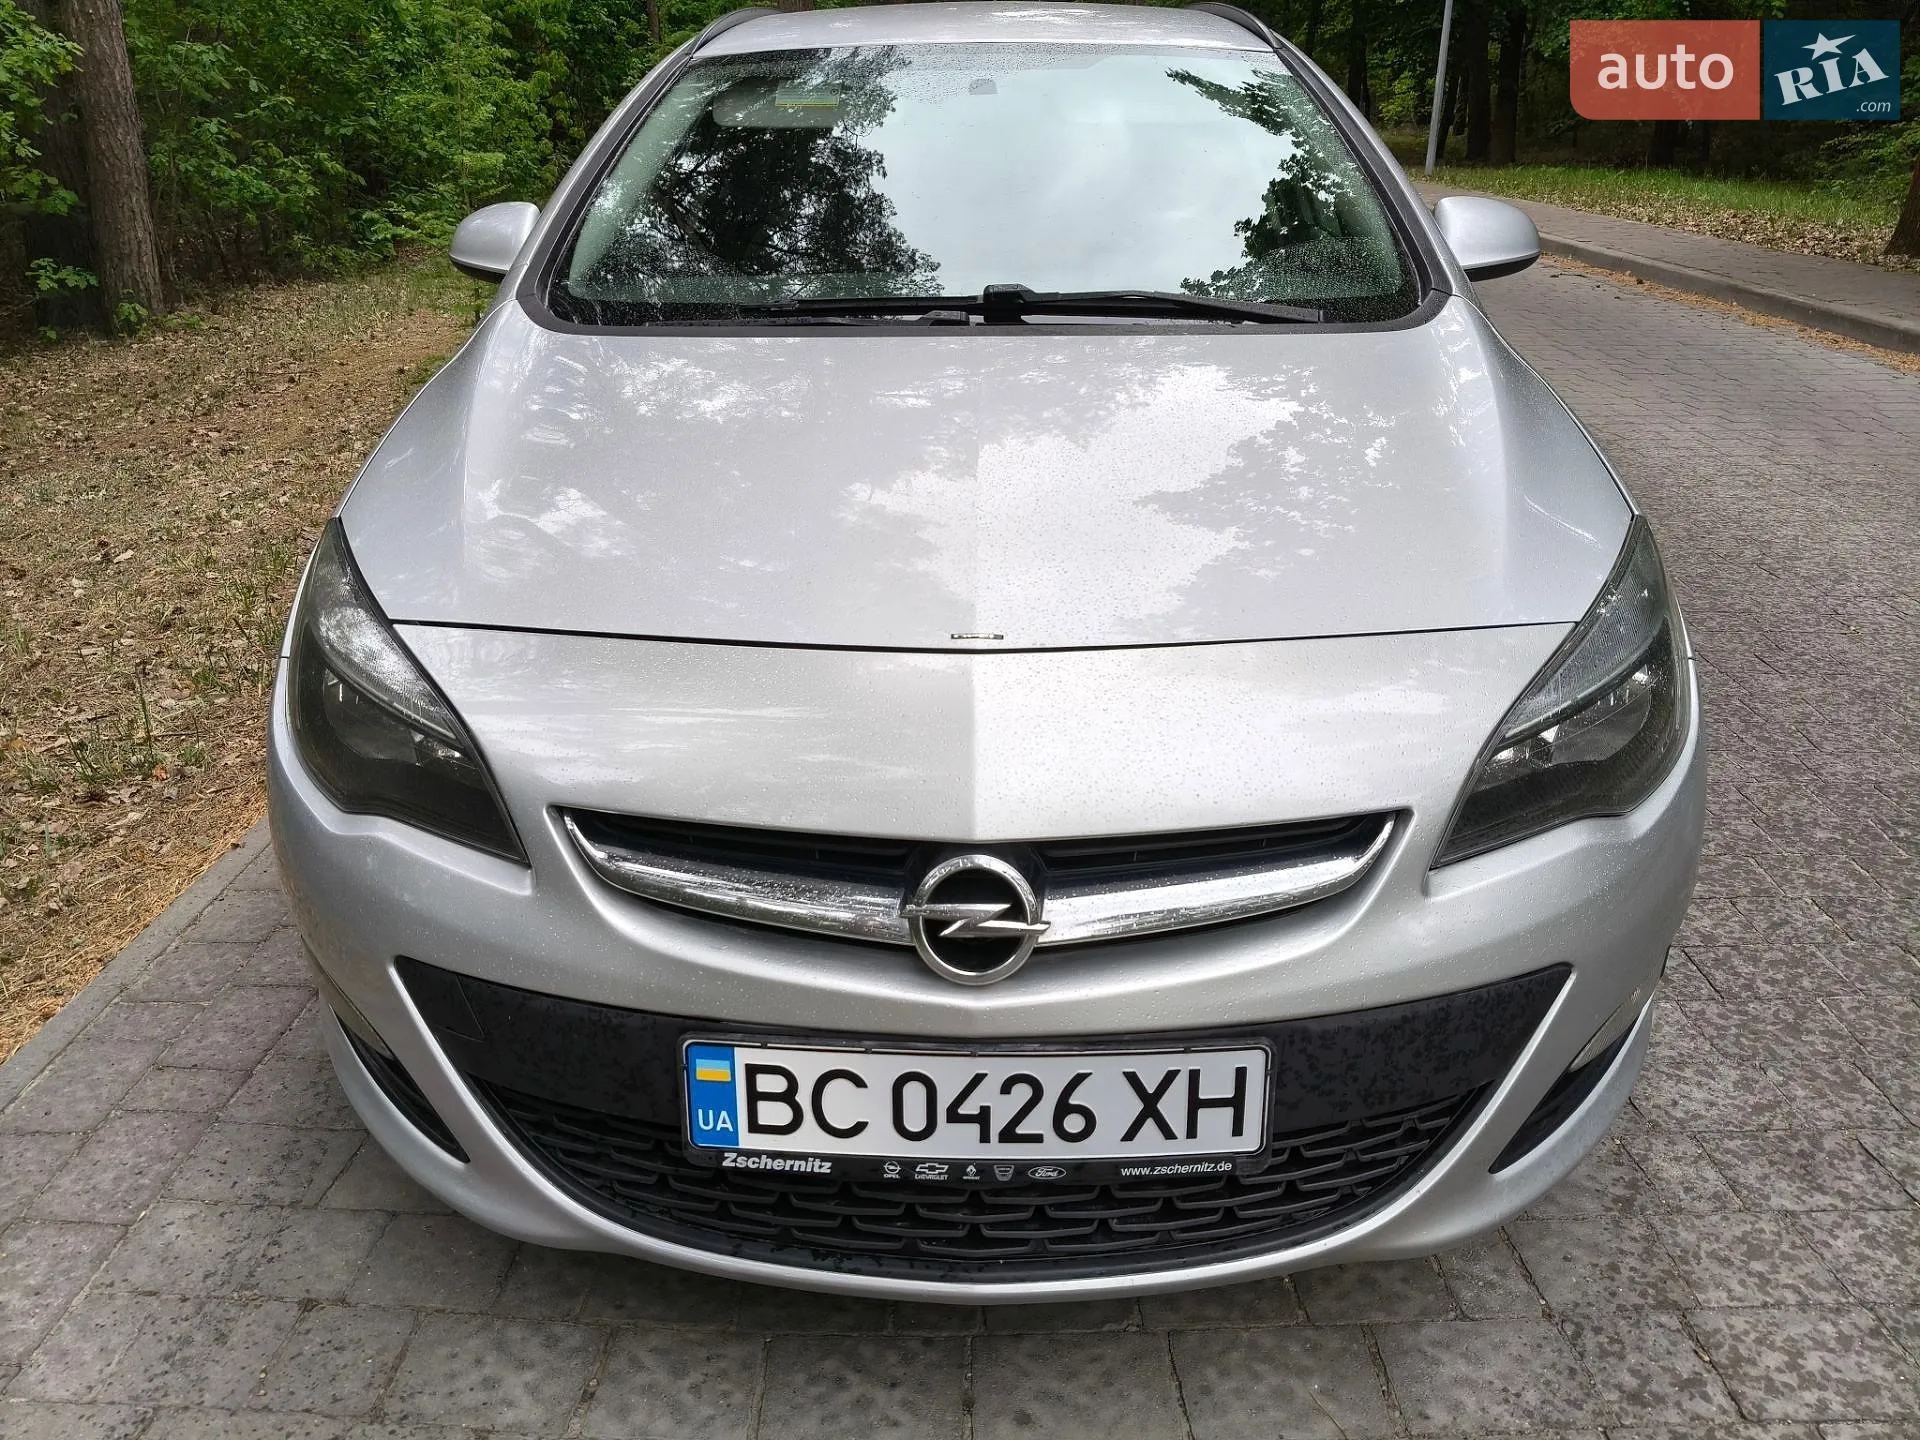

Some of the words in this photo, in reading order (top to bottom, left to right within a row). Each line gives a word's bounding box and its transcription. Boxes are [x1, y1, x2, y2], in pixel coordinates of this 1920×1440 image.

[744, 1063, 869, 1137] BC
[891, 1071, 1098, 1144] 0426
[1119, 1065, 1248, 1142] XH
[699, 1109, 734, 1132] UA
[722, 1152, 832, 1174] Zschernitz
[1120, 1161, 1232, 1177] www.zschernitz.de
